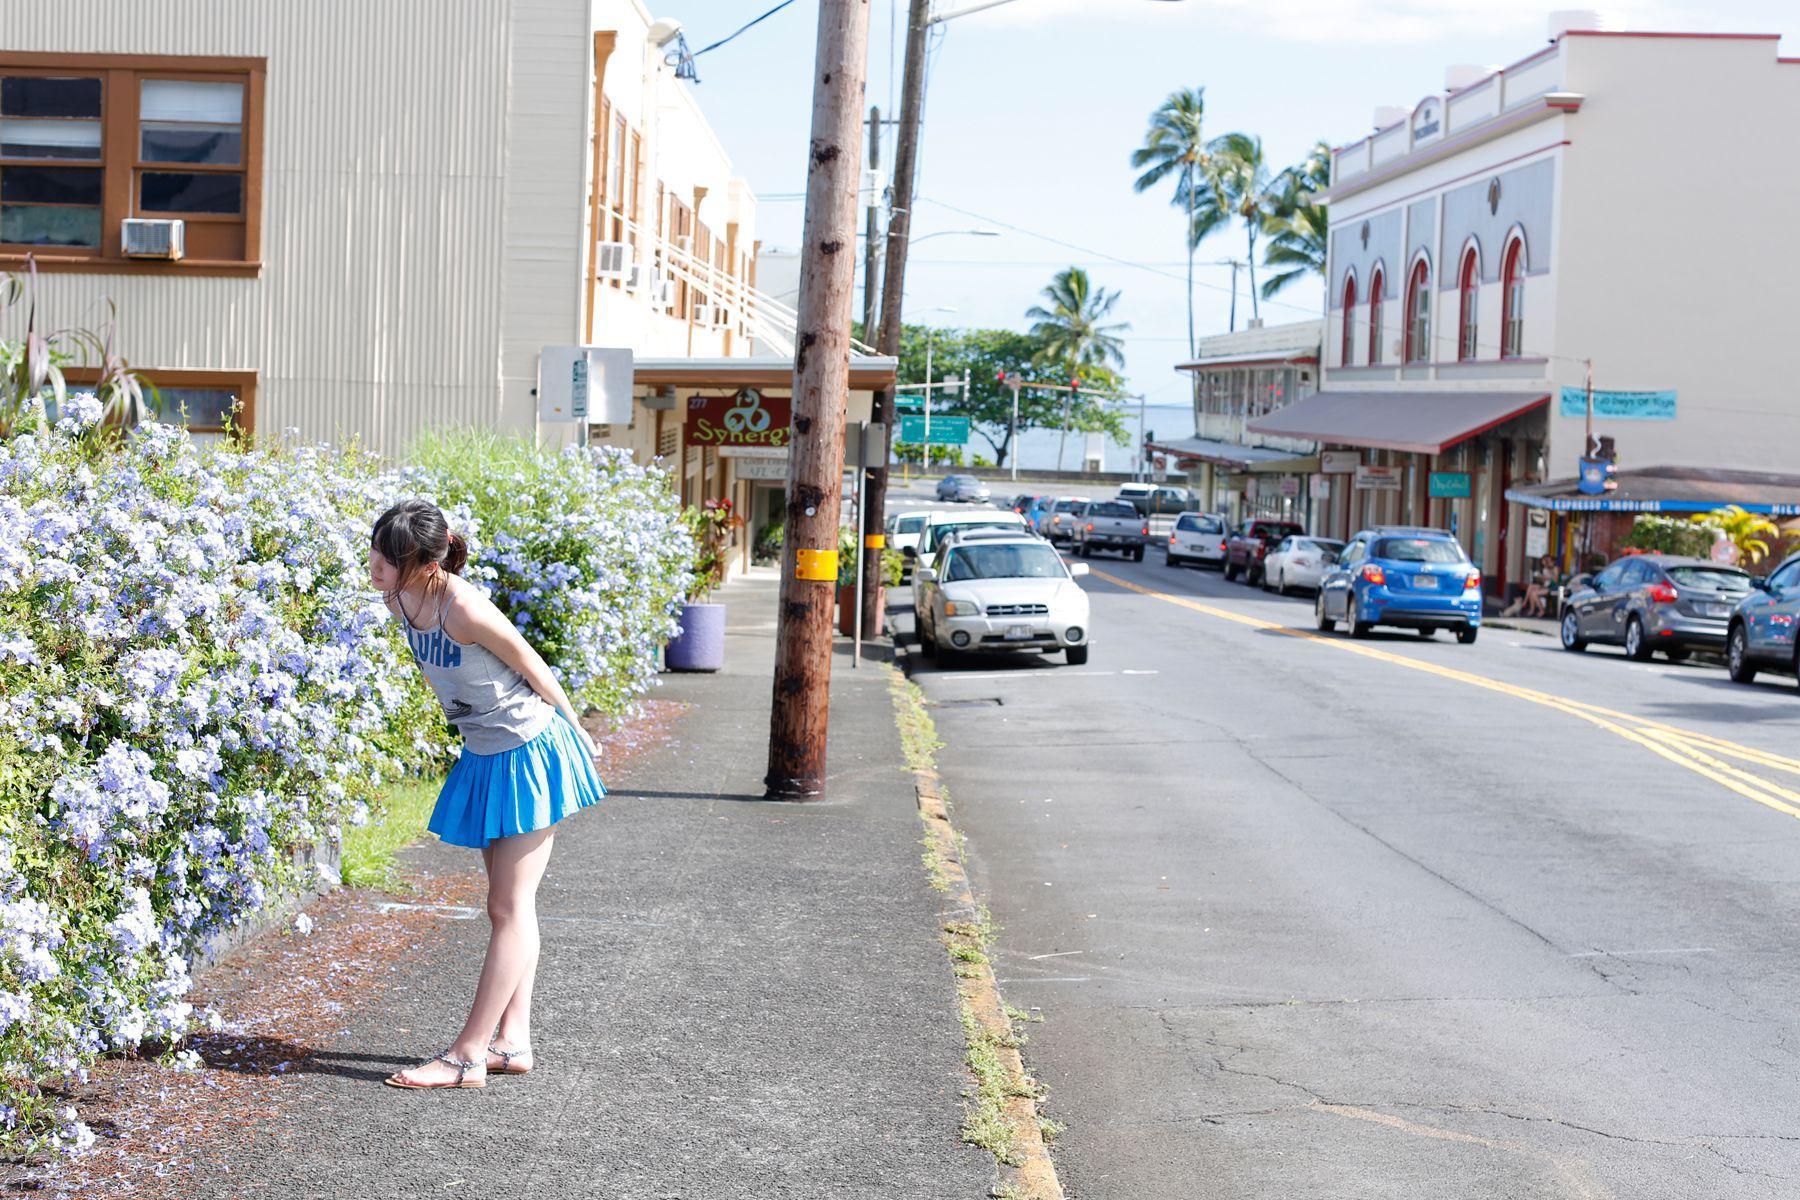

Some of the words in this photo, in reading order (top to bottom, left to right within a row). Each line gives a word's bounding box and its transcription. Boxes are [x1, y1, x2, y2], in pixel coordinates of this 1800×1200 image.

[689, 398, 708, 409] 277
[1554, 499, 1601, 511] ESPRESSO
[1608, 500, 1661, 511] SMOOTHIES
[404, 617, 462, 668] LOHA
